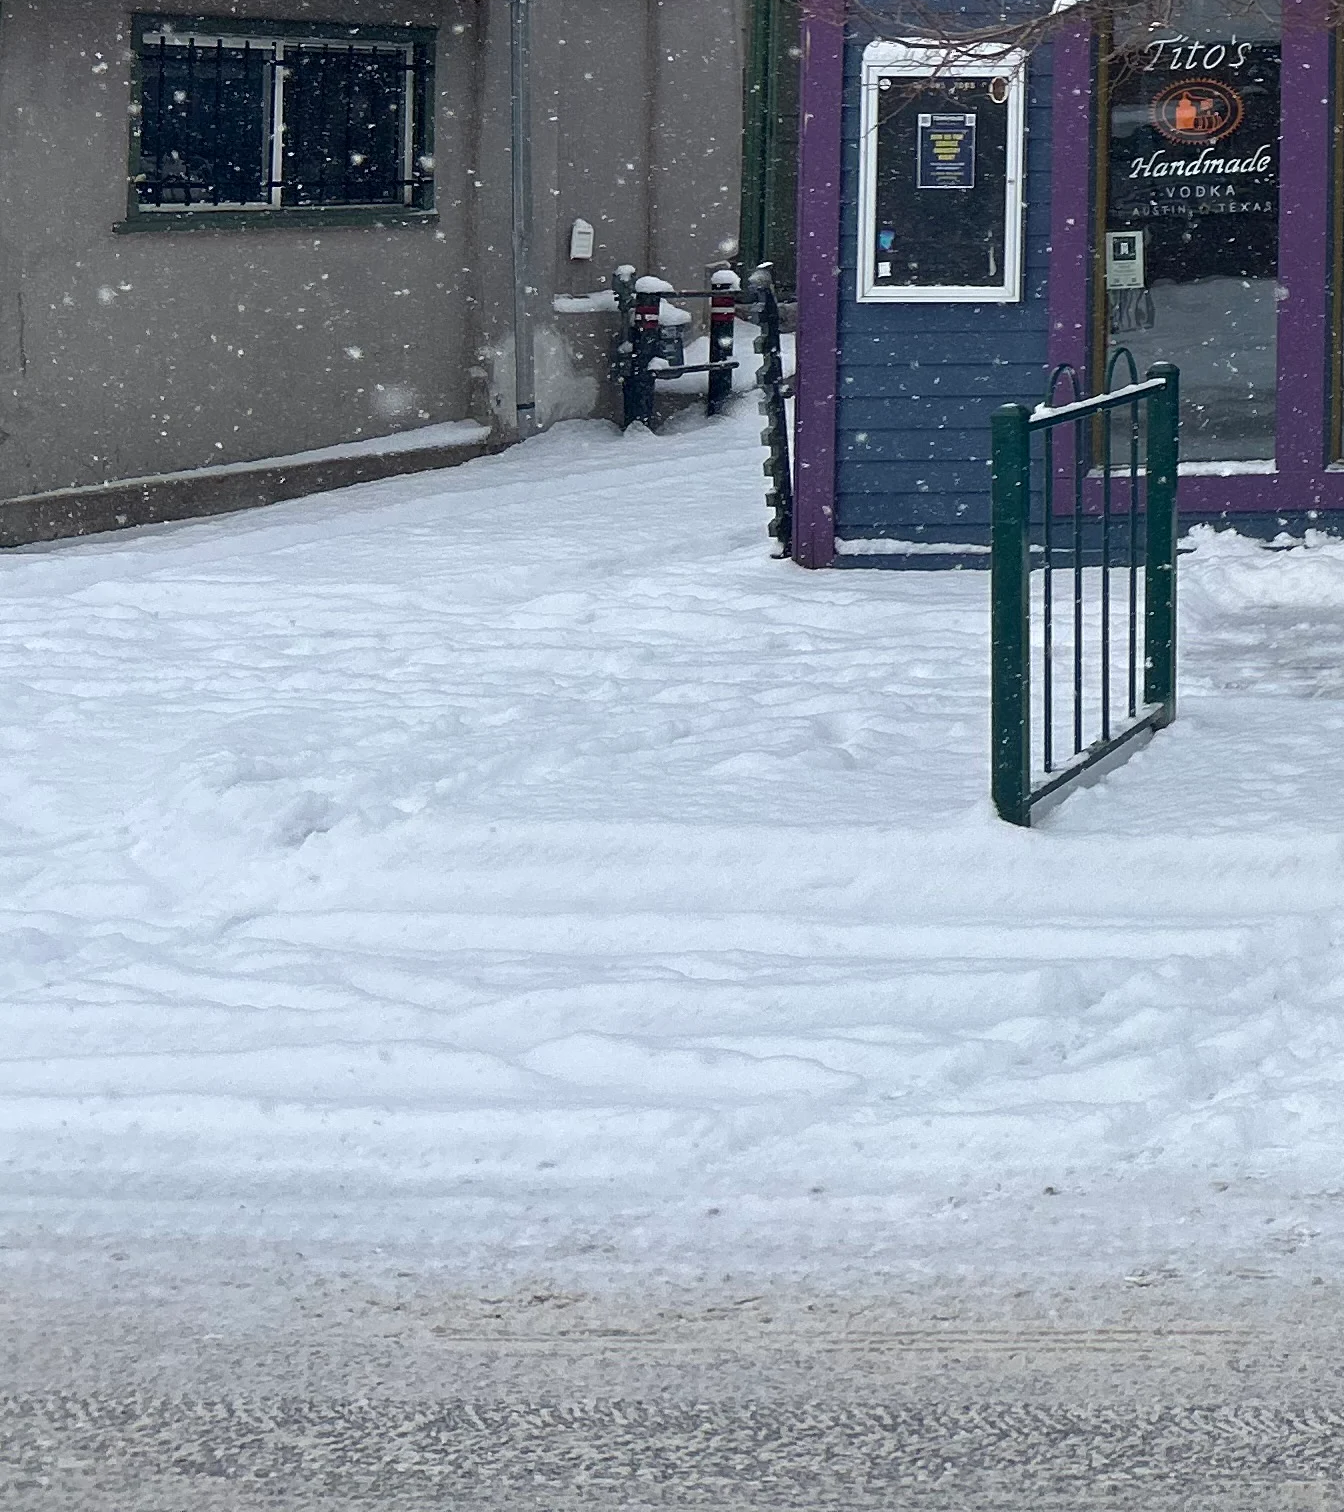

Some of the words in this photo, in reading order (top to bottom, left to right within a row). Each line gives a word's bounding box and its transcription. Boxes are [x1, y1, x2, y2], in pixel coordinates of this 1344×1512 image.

[1144, 34, 1252, 71] Tito's
[1129, 144, 1271, 179] Handmade
[1165, 185, 1236, 198] VODKA
[1218, 201, 1273, 213] TEXAS
